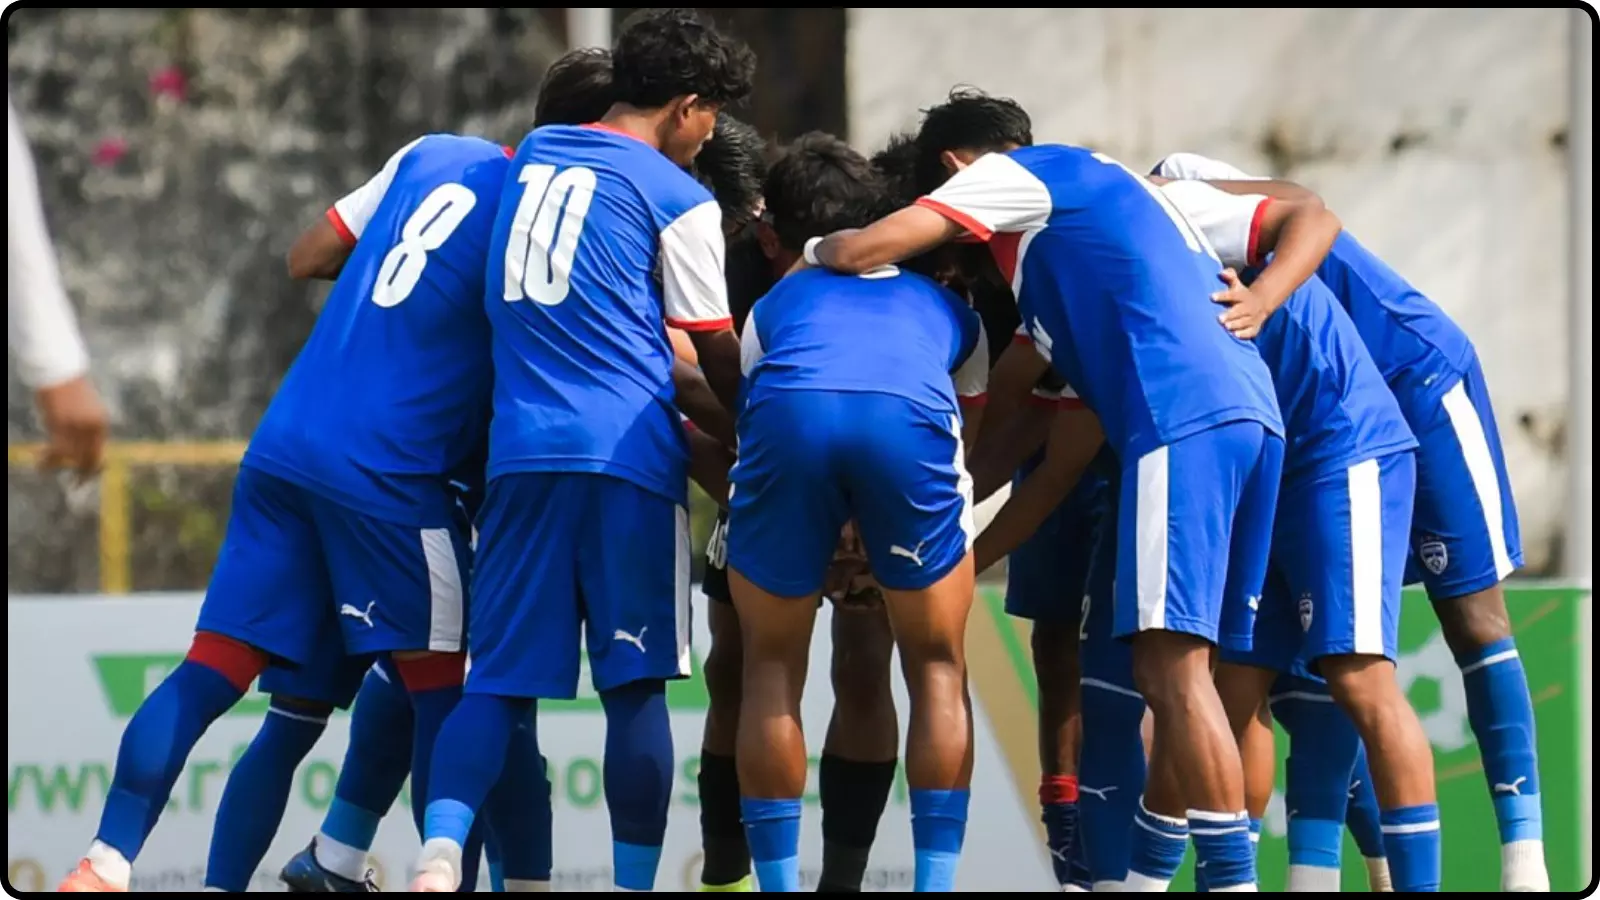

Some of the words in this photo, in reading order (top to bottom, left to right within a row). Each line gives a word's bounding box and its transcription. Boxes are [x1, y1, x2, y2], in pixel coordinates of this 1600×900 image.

[372, 183, 476, 308] 8
[503, 163, 597, 306] 10
[706, 518, 728, 570] 46
